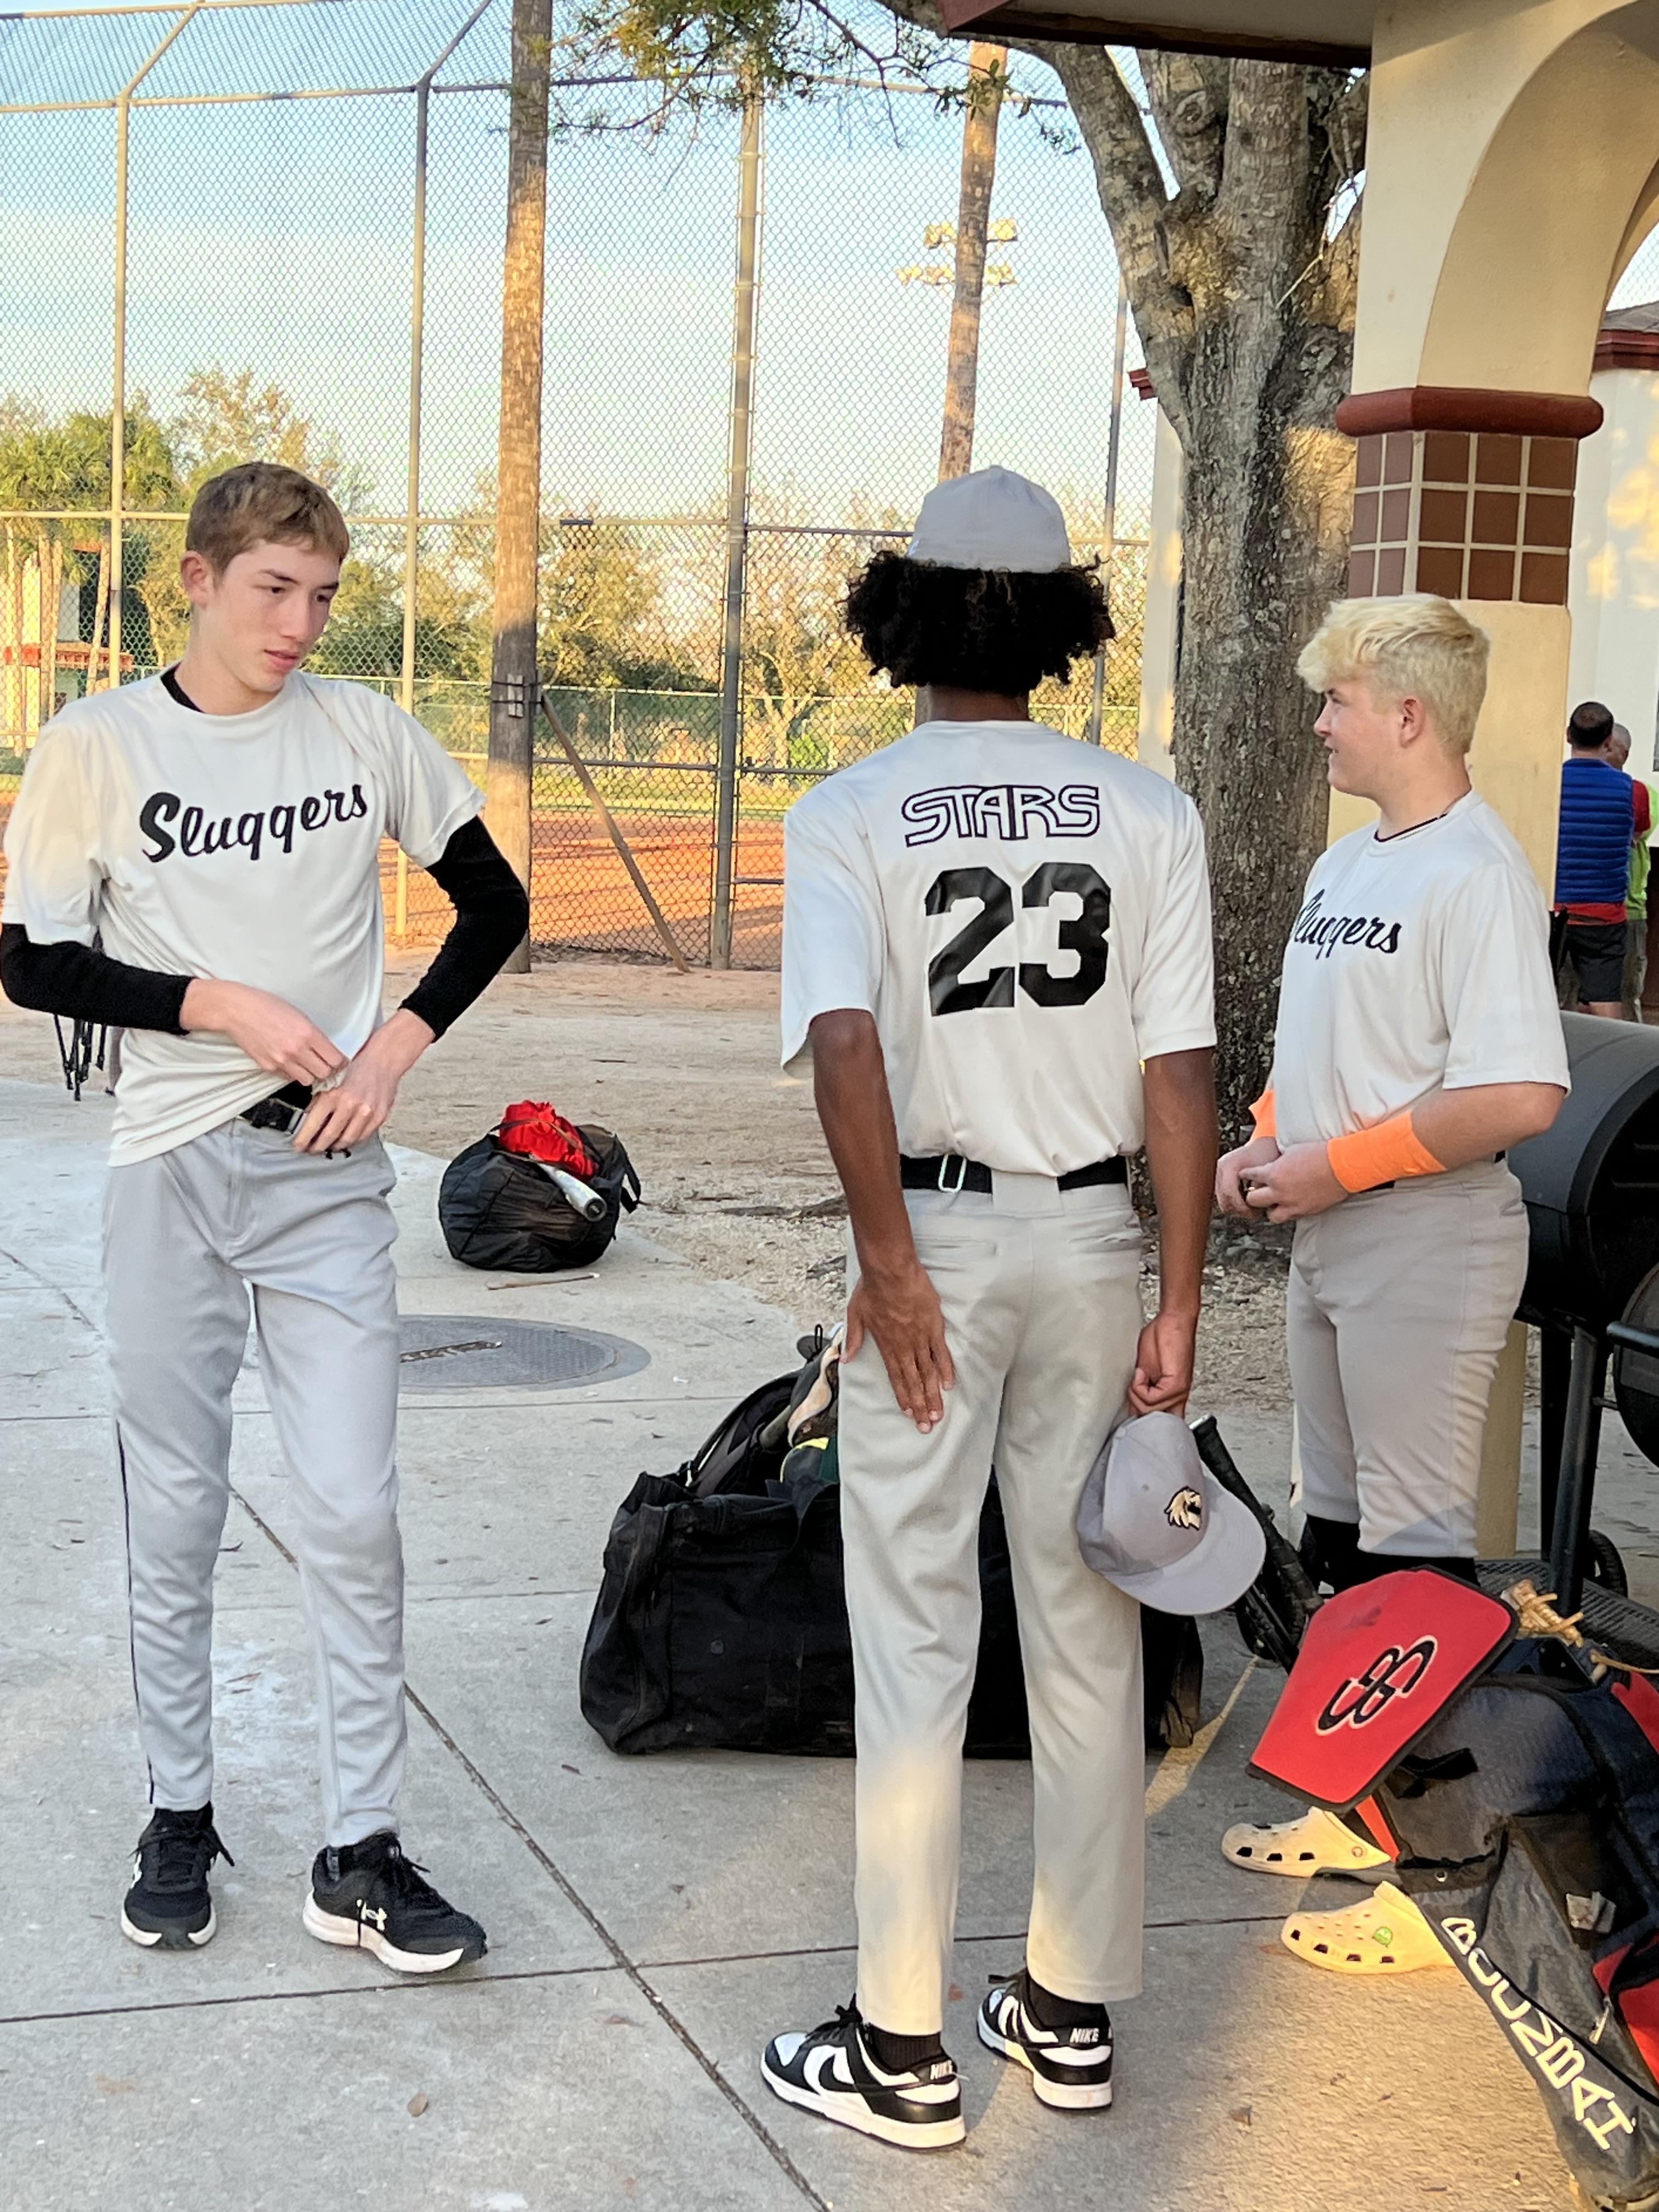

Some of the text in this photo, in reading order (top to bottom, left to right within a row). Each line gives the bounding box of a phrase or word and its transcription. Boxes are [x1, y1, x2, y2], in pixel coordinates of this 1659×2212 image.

[139, 784, 367, 862] Sluggers
[901, 785, 1100, 848] STARS
[924, 861, 1111, 1017] 23
[1069, 2027, 1099, 2044] NIKE
